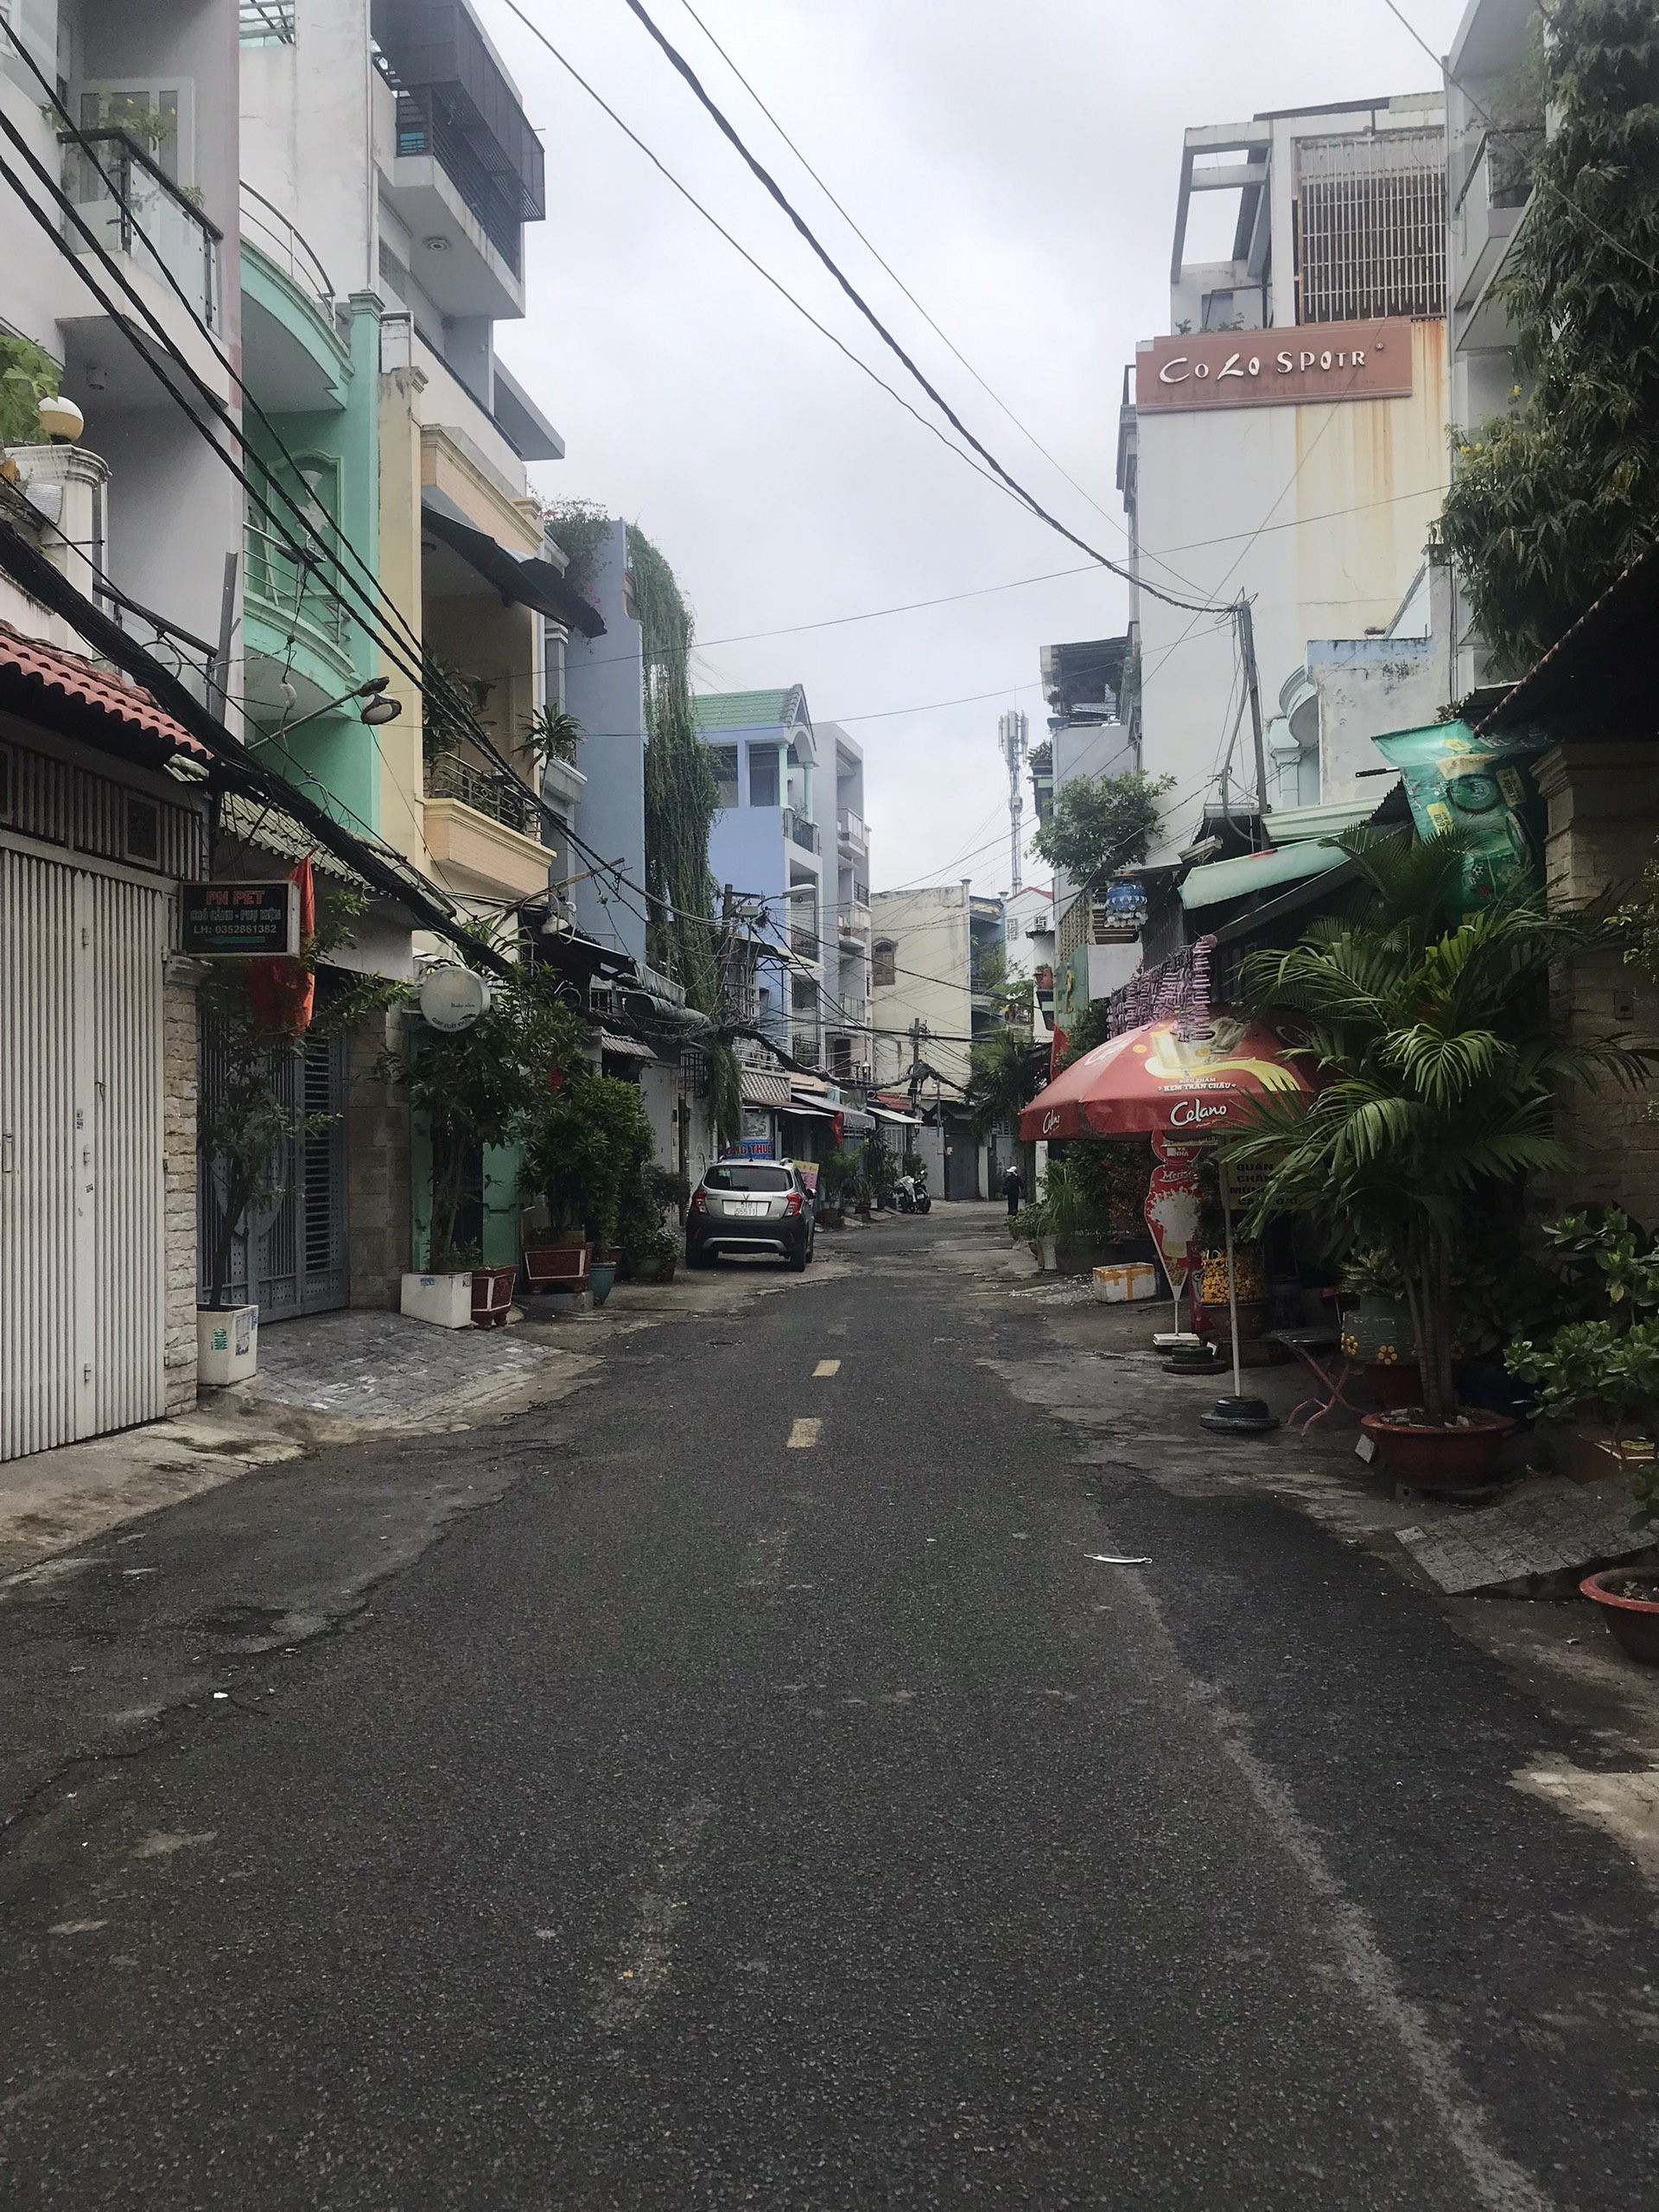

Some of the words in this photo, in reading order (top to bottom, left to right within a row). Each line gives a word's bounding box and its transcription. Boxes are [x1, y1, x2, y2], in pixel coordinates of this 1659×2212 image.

[206, 891, 229, 906] PN
[232, 890, 265, 906] PET
[1169, 1098, 1228, 1127] Celano
